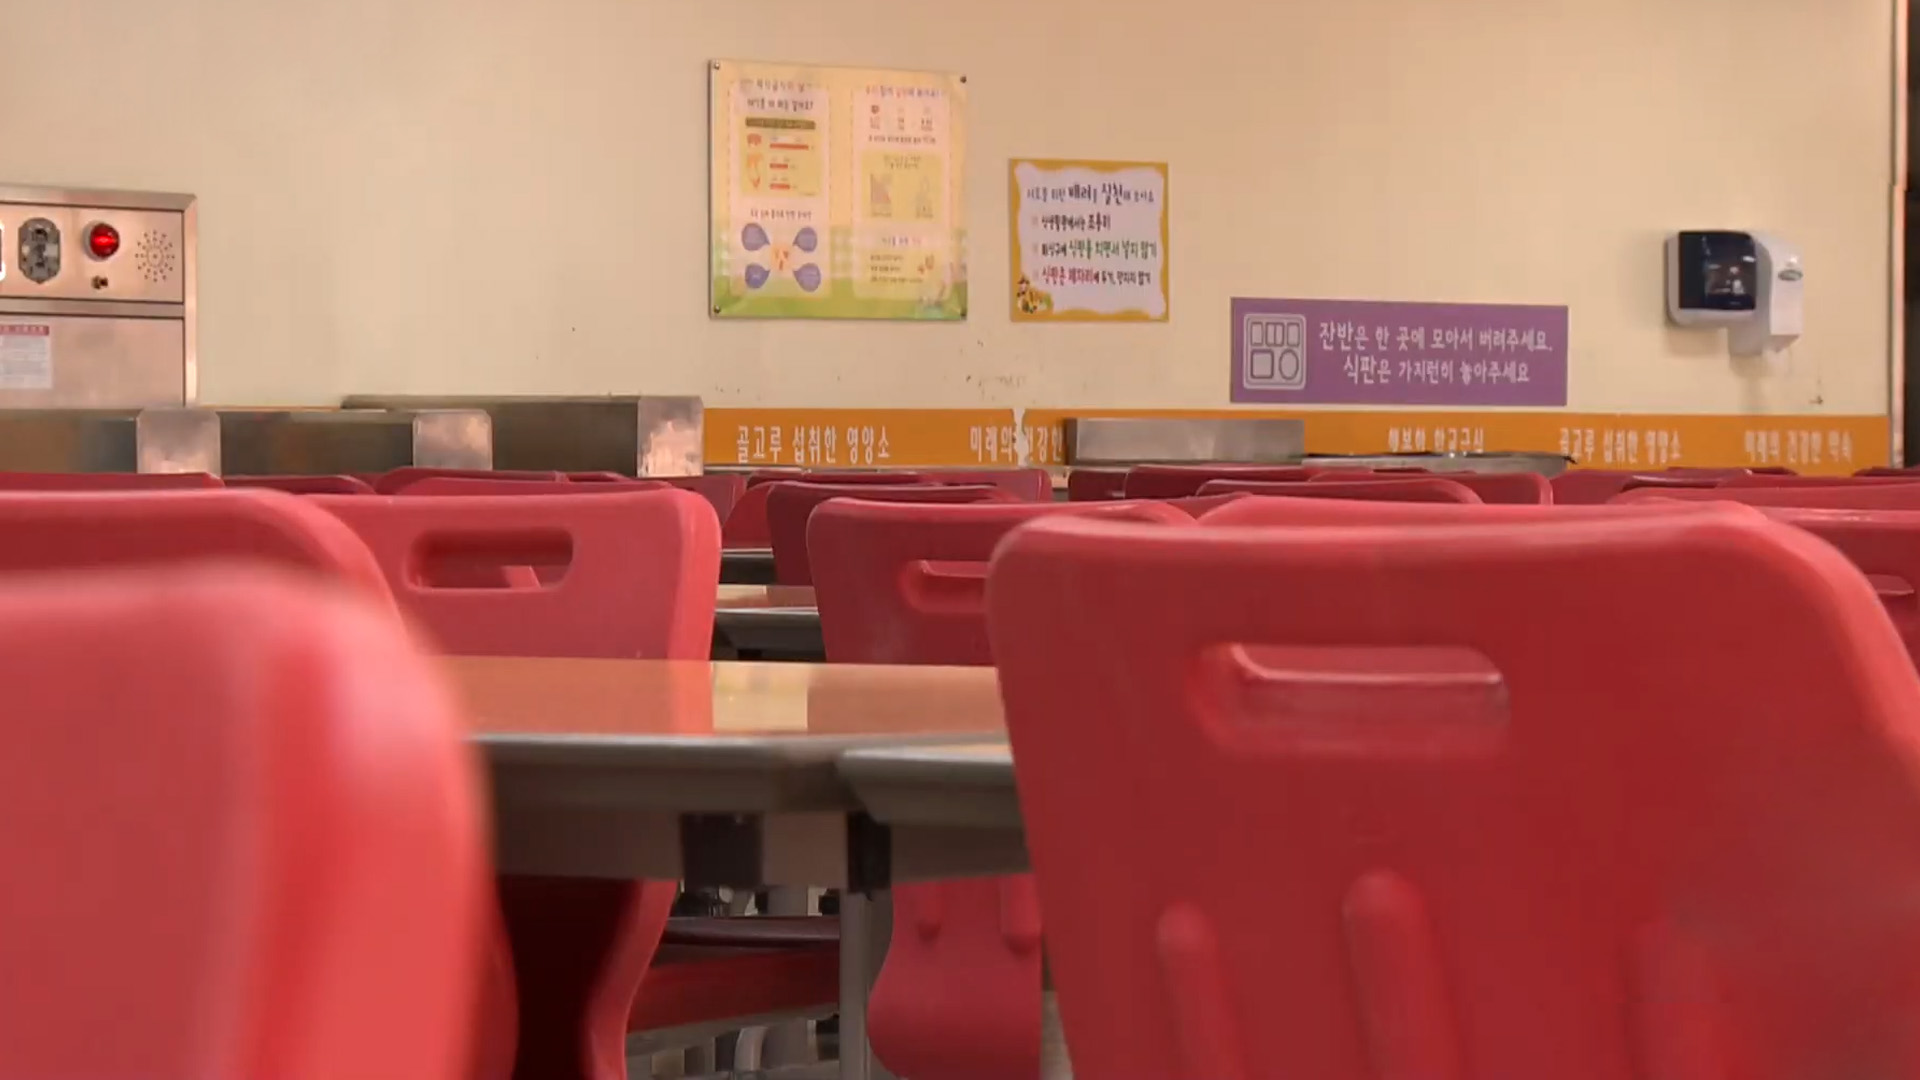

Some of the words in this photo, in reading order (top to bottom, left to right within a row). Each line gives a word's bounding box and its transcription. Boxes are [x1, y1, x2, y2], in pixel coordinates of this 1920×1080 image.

[1068, 183, 1098, 204] 배려를
[1319, 319, 1370, 351] 잔반은
[1375, 325, 1390, 351] 한
[1397, 325, 1426, 351] 곳에
[1430, 326, 1474, 351] 모아서
[1478, 326, 1553, 353] 버려주세요.
[1343, 353, 1393, 385] 식판은
[1398, 358, 1454, 385] 가지런히
[1459, 358, 1531, 385] 놓아주세요
[736, 425, 783, 465] 골고루
[792, 425, 838, 465] 섭취한
[846, 425, 891, 465] 영양소
[969, 425, 1013, 463] 미래의
[1558, 427, 1596, 463] 골고루
[1603, 428, 1639, 464] 섭취한
[1644, 428, 1682, 465] 영양소
